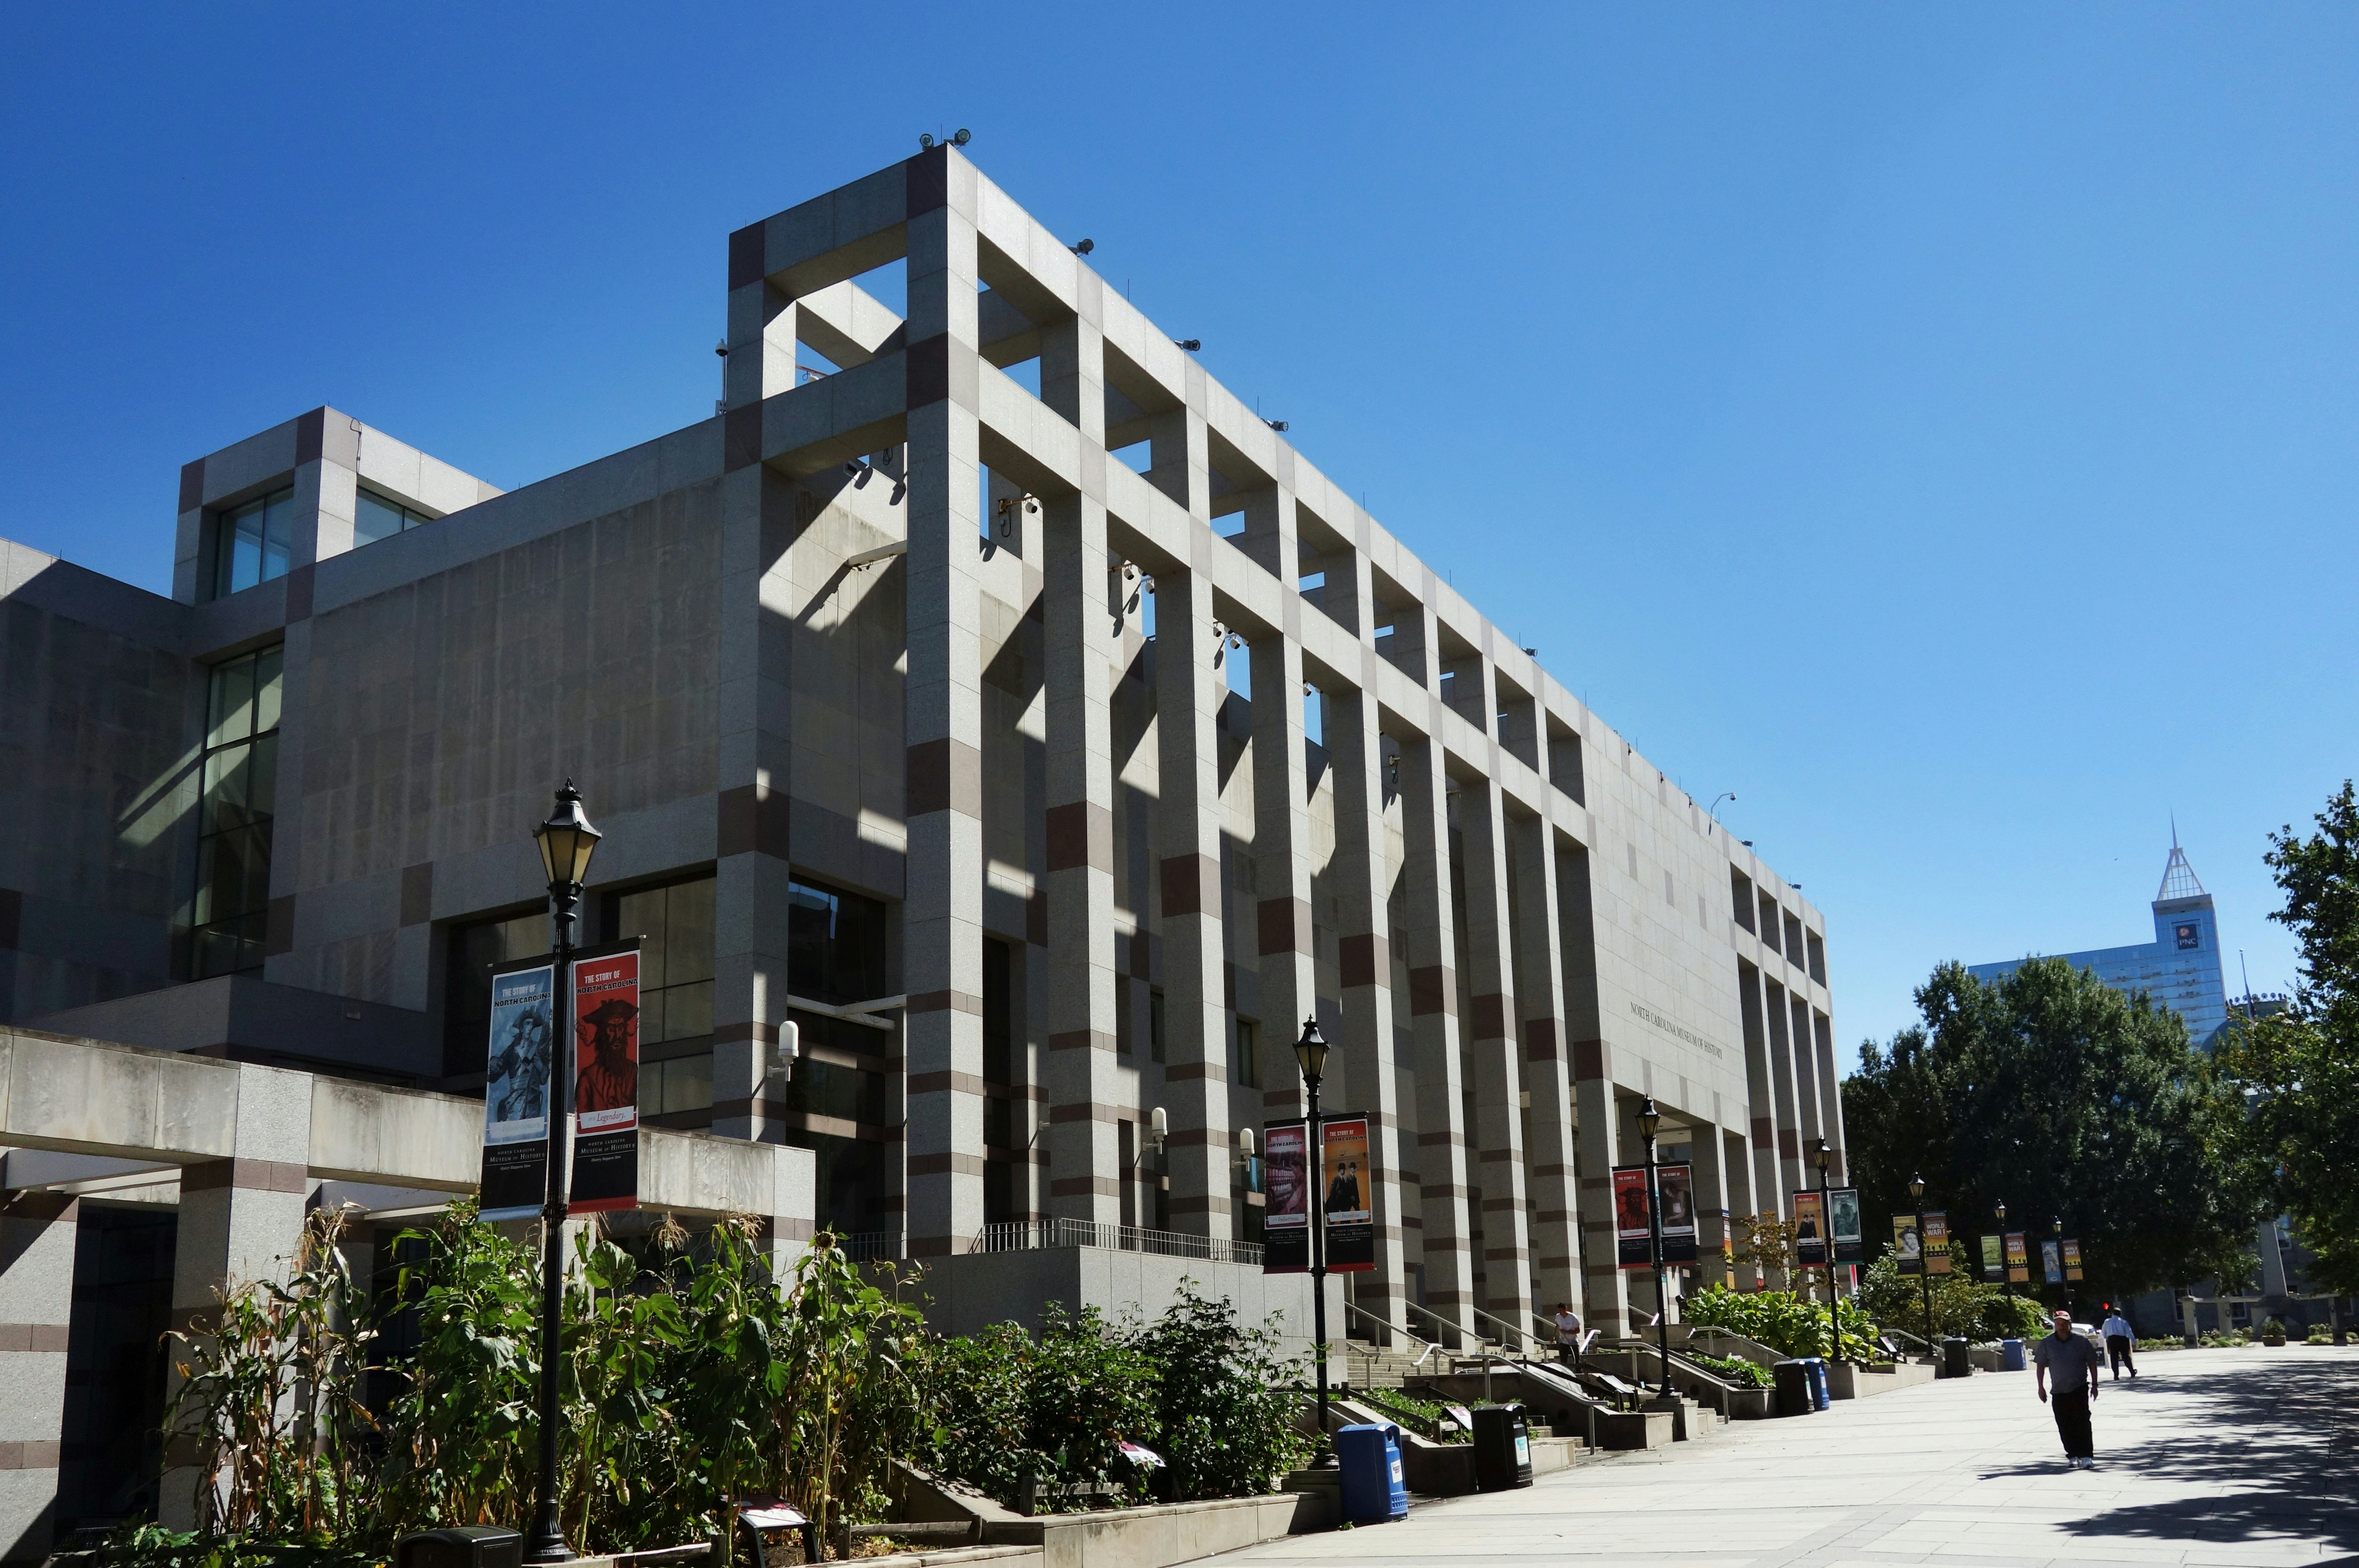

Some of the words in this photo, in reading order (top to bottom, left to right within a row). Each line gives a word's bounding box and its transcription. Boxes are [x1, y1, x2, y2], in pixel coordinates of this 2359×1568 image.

[584, 975, 595, 984] THE
[596, 972, 612, 982] STORY
[613, 970, 620, 979] OF
[502, 988, 512, 997] THE
[513, 985, 529, 995] STORY
[529, 984, 536, 992] OF
[577, 985, 601, 995] NORTH
[603, 978, 638, 991] CAROLINA
[494, 999, 518, 1008] NORTH
[519, 992, 551, 1004] CAROLINA
[1630, 1002, 1649, 1022] NORTH
[1651, 1013, 1676, 1036] CAROLINA
[1677, 1026, 1697, 1046] MUSEUM
[1698, 1037, 1703, 1049] OF
[1704, 1041, 1722, 1059] HISTORY
